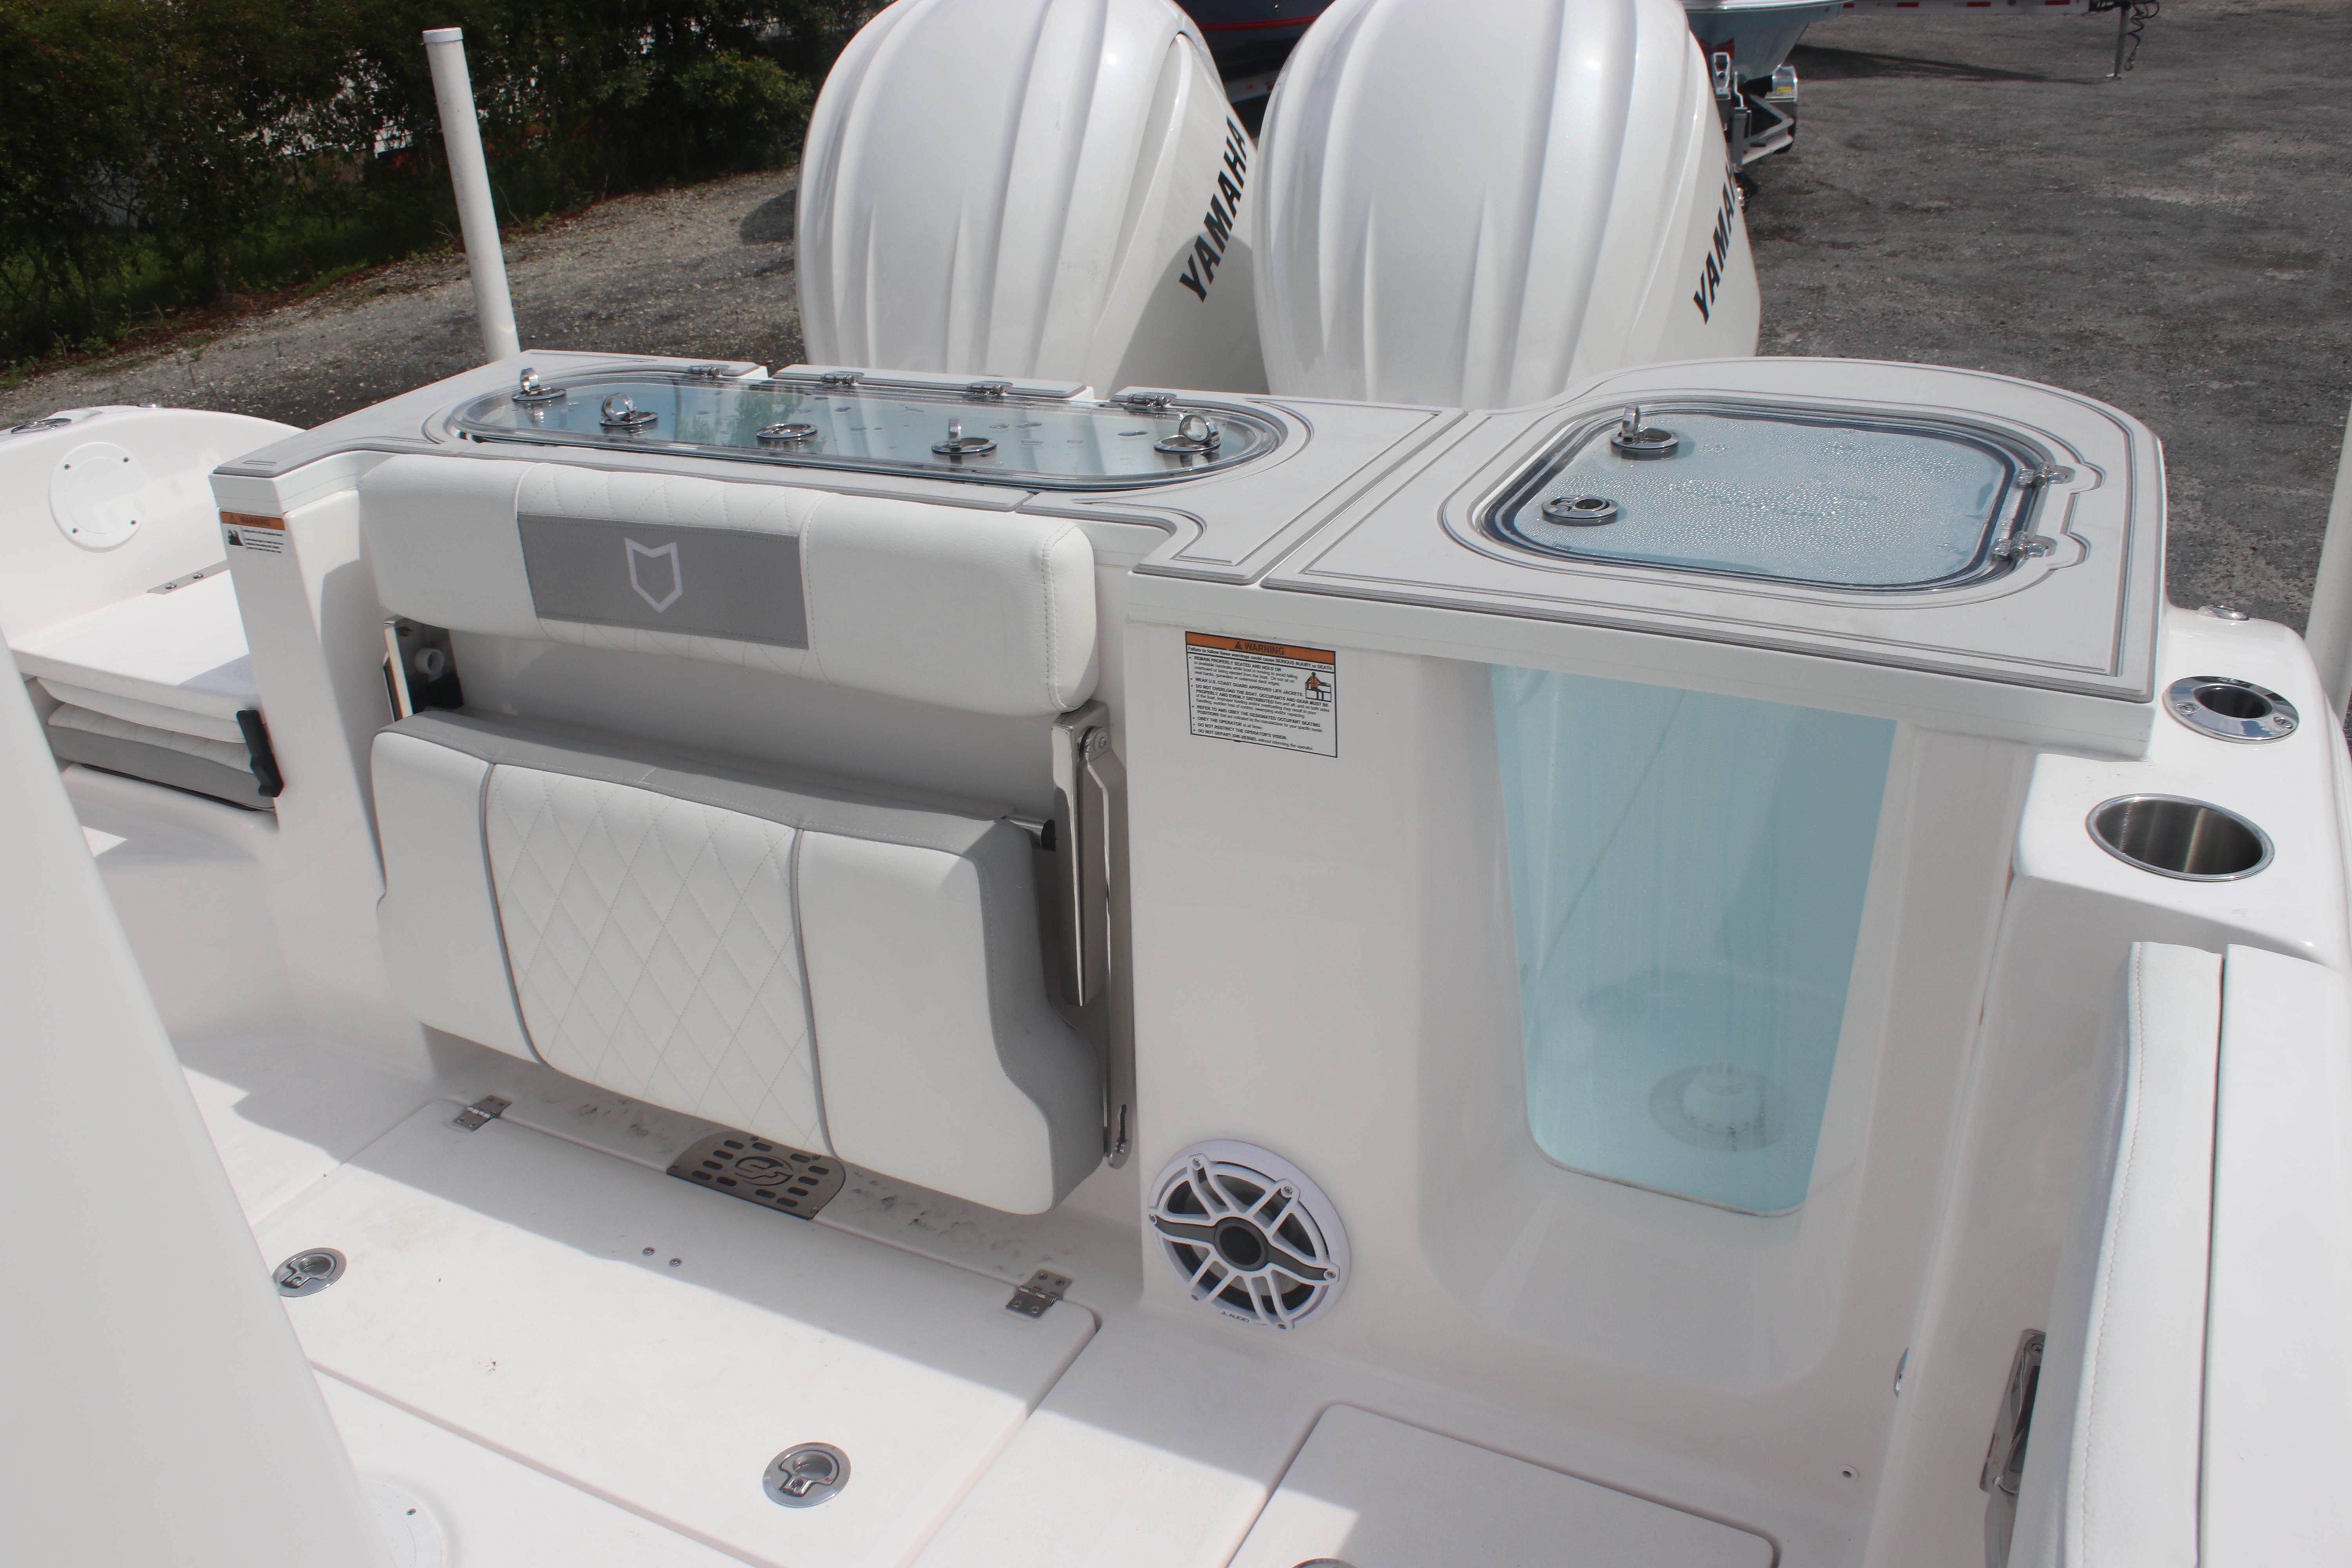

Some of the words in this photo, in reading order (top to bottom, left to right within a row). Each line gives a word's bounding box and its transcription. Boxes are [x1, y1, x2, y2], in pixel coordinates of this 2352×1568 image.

[1180, 115, 1247, 303] YAMAHA
[1244, 642, 1284, 655] WARNING
[1229, 1313, 1249, 1323] AUDIO
